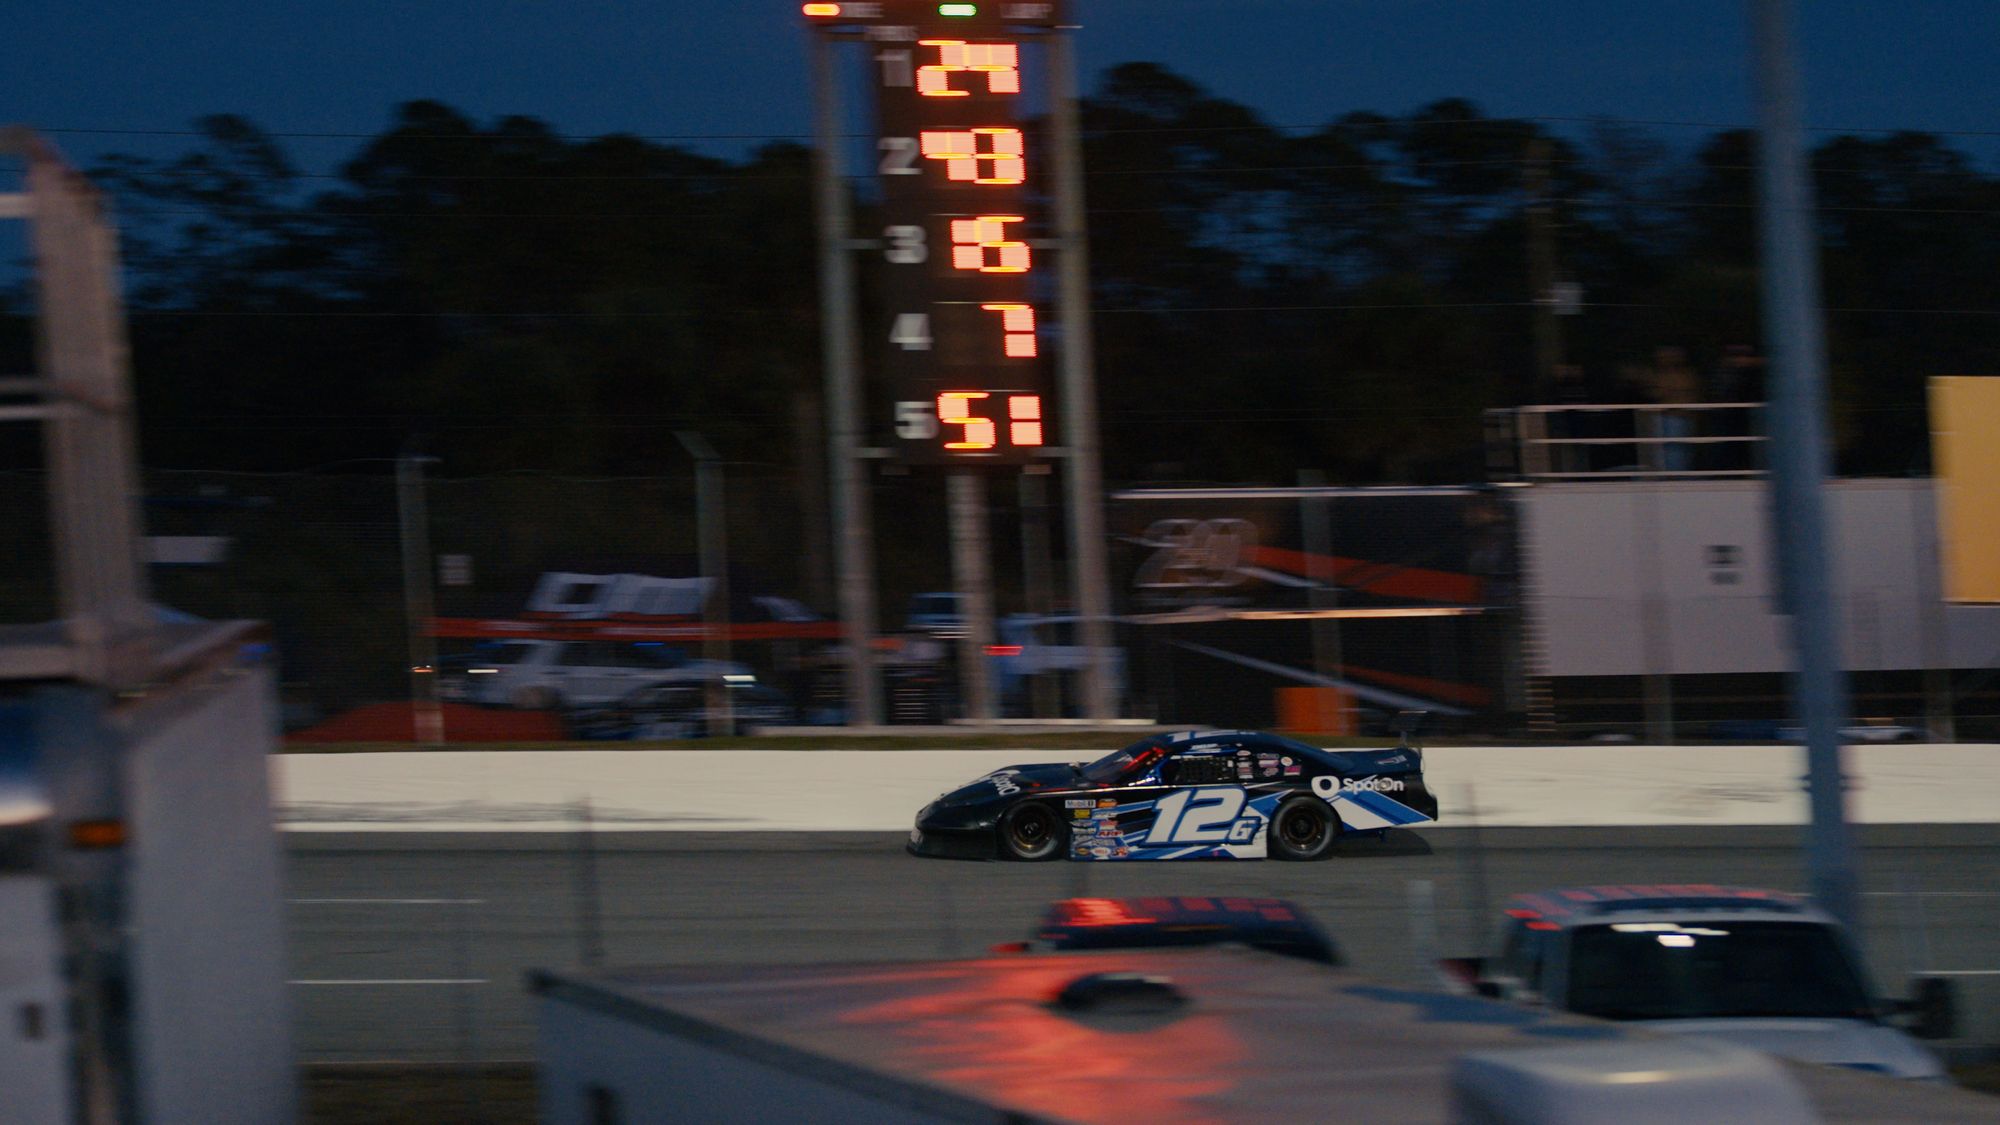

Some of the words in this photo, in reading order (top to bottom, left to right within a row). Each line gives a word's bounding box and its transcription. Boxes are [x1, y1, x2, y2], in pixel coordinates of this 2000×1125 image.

[877, 49, 913, 87] 1
[916, 39, 1020, 96] 24
[876, 136, 922, 175] 2
[919, 127, 1025, 184] 48
[884, 225, 929, 264] 3
[951, 216, 1032, 273] 16
[888, 313, 934, 351] 4
[980, 304, 1038, 357] 7
[894, 401, 939, 439] 5
[937, 392, 1043, 449] 51
[1144, 788, 1245, 843] 12
